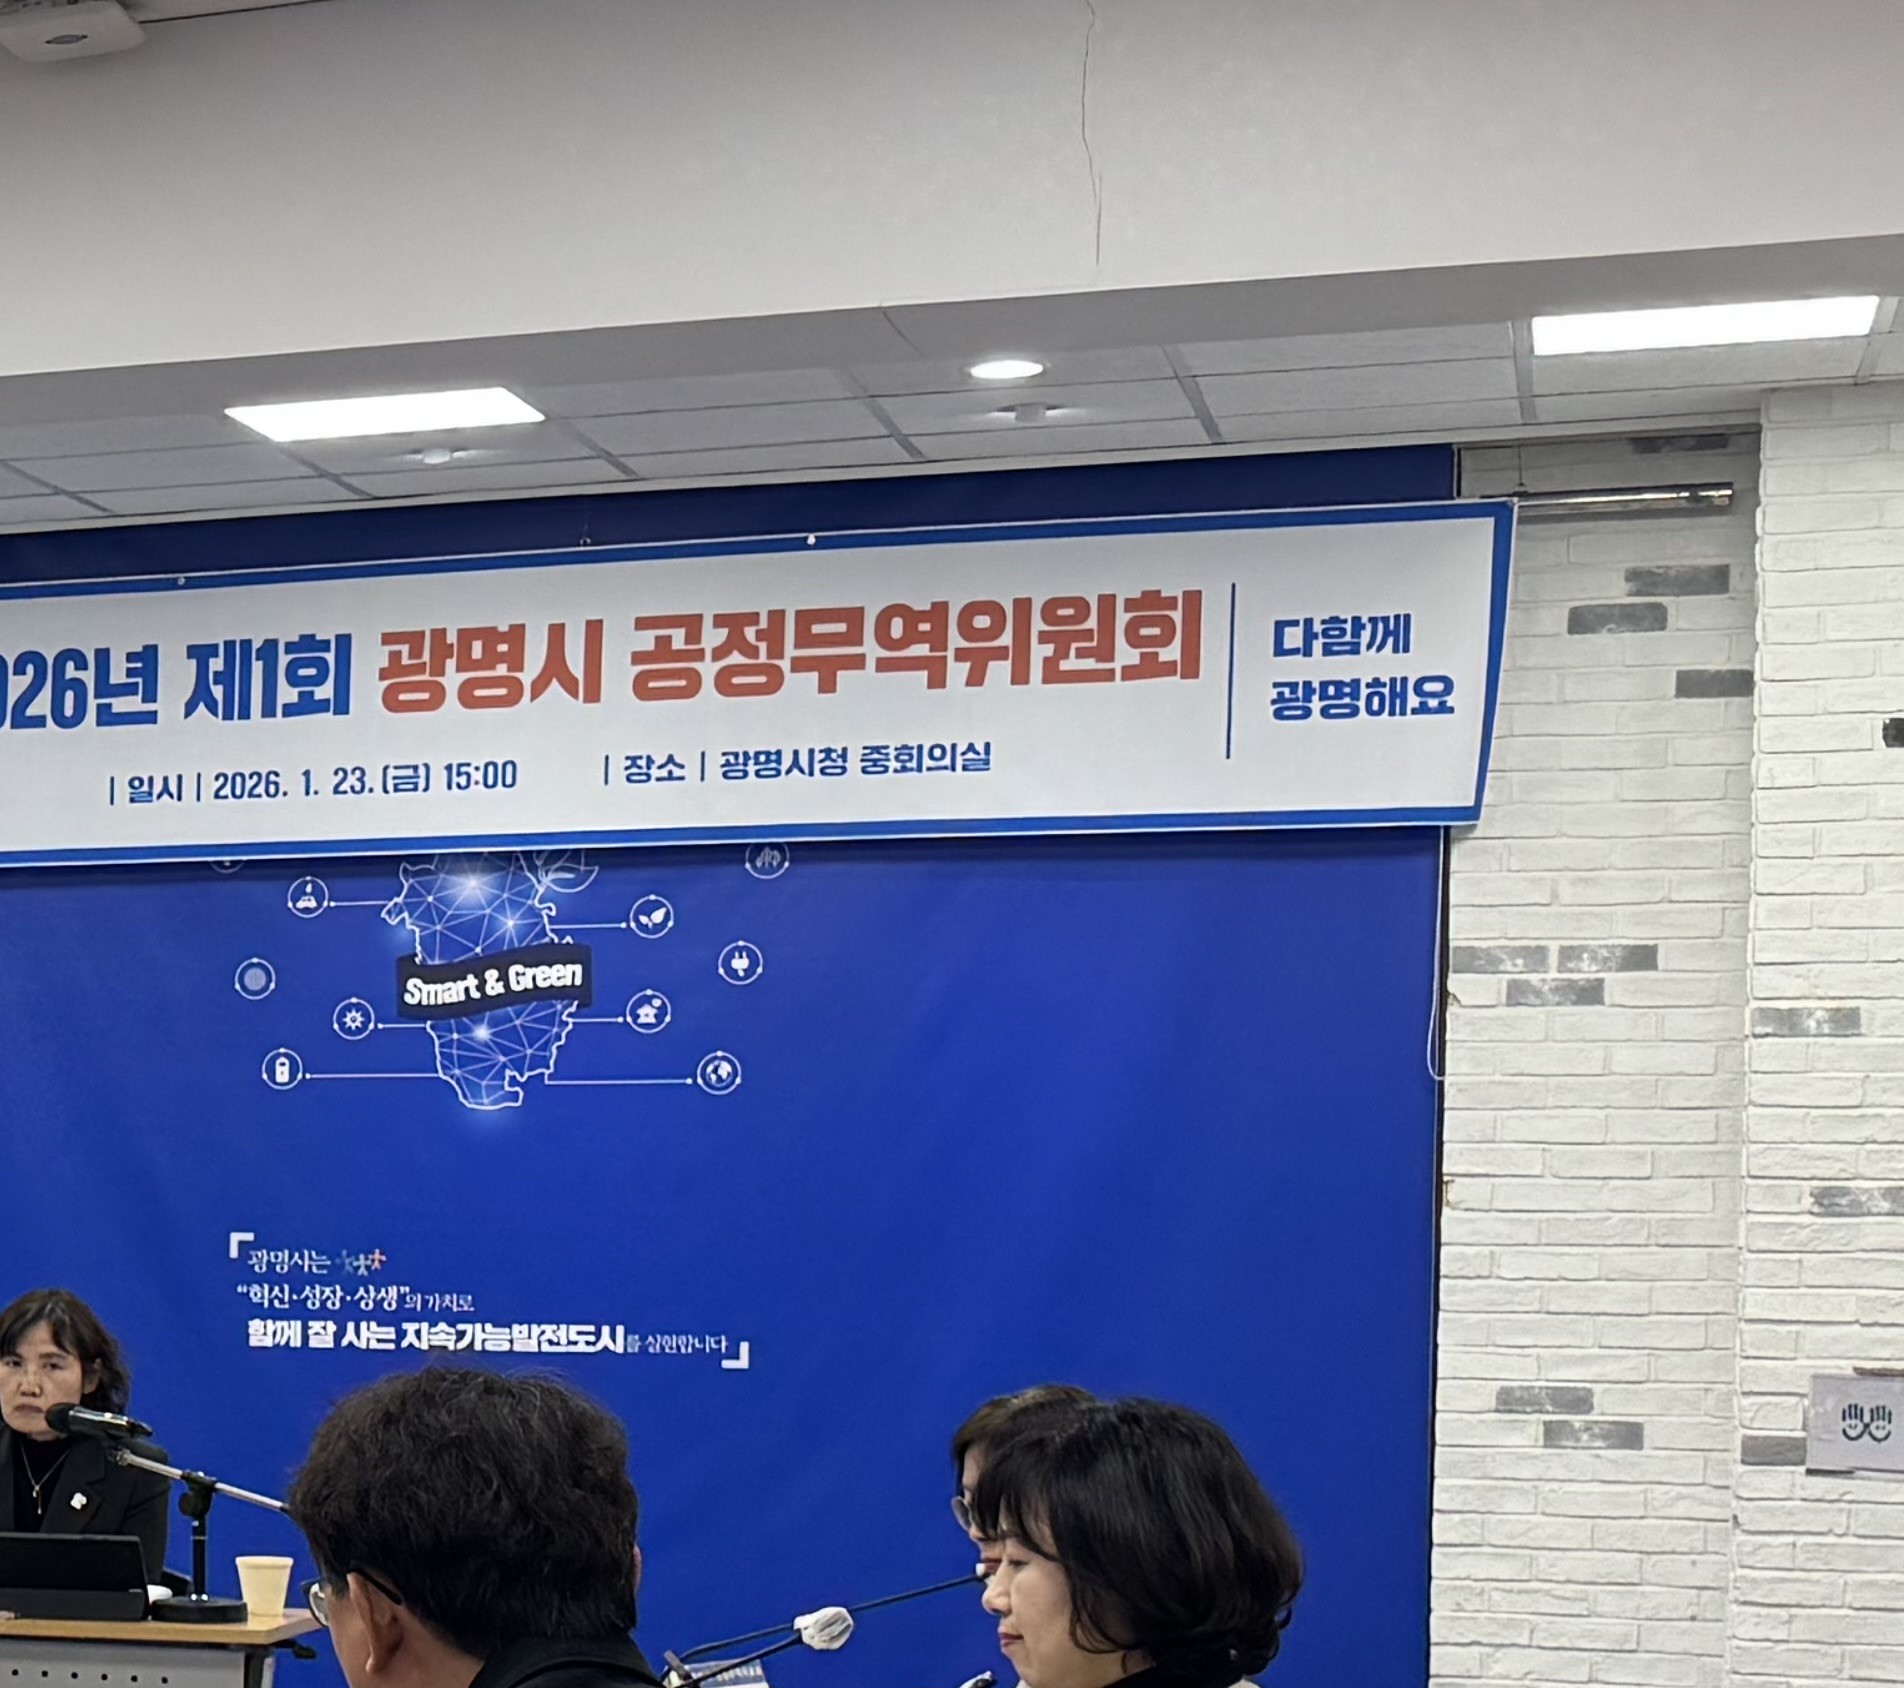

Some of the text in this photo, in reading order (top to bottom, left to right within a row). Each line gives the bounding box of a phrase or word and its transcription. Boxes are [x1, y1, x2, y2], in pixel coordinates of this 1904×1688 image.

[184, 633, 353, 721] 제1회
[378, 613, 603, 714] 광명시
[630, 590, 1201, 703] 공정무역위원회
[1272, 612, 1412, 659] 다함께
[1270, 674, 1455, 721] 광명해요
[128, 773, 183, 804] 일시
[213, 771, 288, 800] 2026.
[301, 769, 319, 797] 1.
[444, 760, 517, 790] 15:00
[623, 741, 991, 784] 장소 광명시청 중회의실
[403, 963, 583, 1006] Smart & Green
[248, 1318, 302, 1348] 함께
[308, 1320, 337, 1349] 잘
[341, 1320, 396, 1350] 사는
